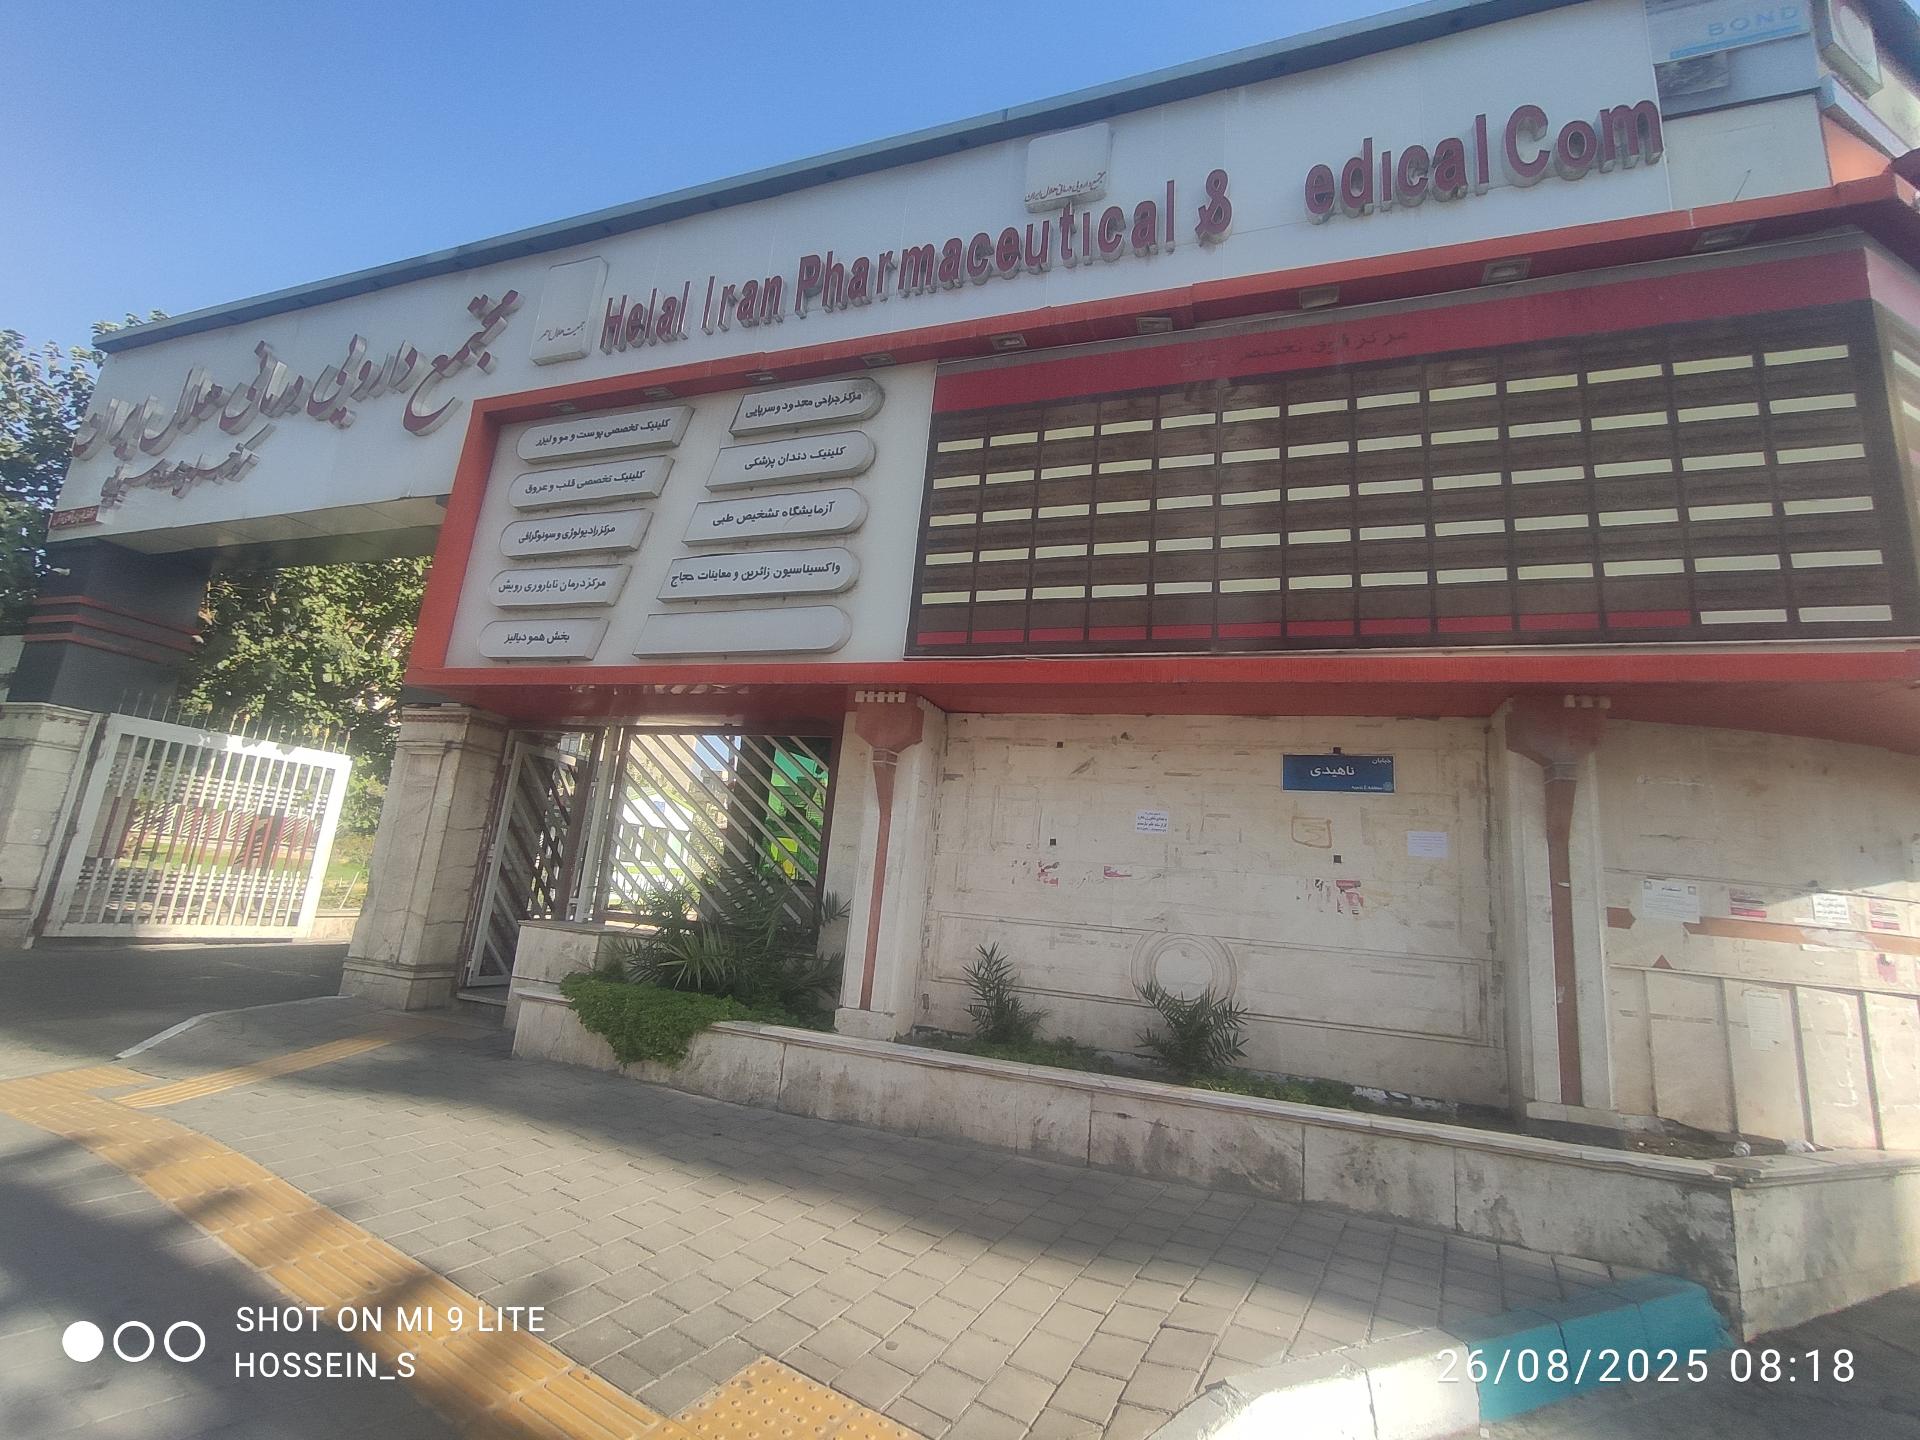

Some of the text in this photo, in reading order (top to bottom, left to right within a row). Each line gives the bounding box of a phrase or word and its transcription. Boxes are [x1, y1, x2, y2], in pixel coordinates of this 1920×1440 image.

[1708, 6, 1798, 37] BOND
[600, 281, 691, 354] Helal
[701, 275, 784, 335] Iran
[794, 179, 1178, 318] Pharmaceutical
[1504, 99, 1665, 188] Com
[403, 289, 522, 435] مجتمع
[814, 394, 841, 408] جراحی
[840, 391, 862, 404] مرکز
[745, 404, 776, 418] سرپایی
[774, 405, 781, 414] و
[535, 418, 671, 447] کلینیک تخصصی پوست و مو و لیزر
[744, 445, 847, 470] کلینیک دندان پزشکی
[525, 470, 646, 494] کلینیک تخصصی قلب و عروق
[712, 501, 836, 526] آزمایشگاه تشخیص طبی
[518, 524, 616, 544] مرکز رادیولوژی و سونوگرافی
[498, 577, 607, 593] مرکز درمان ناباروری رویش
[670, 561, 841, 587] واکسیناسیون زائرین و معاینات حجاج
[503, 631, 570, 645] بخش همو دیالیز
[1310, 765, 1355, 778] ناهیدی
